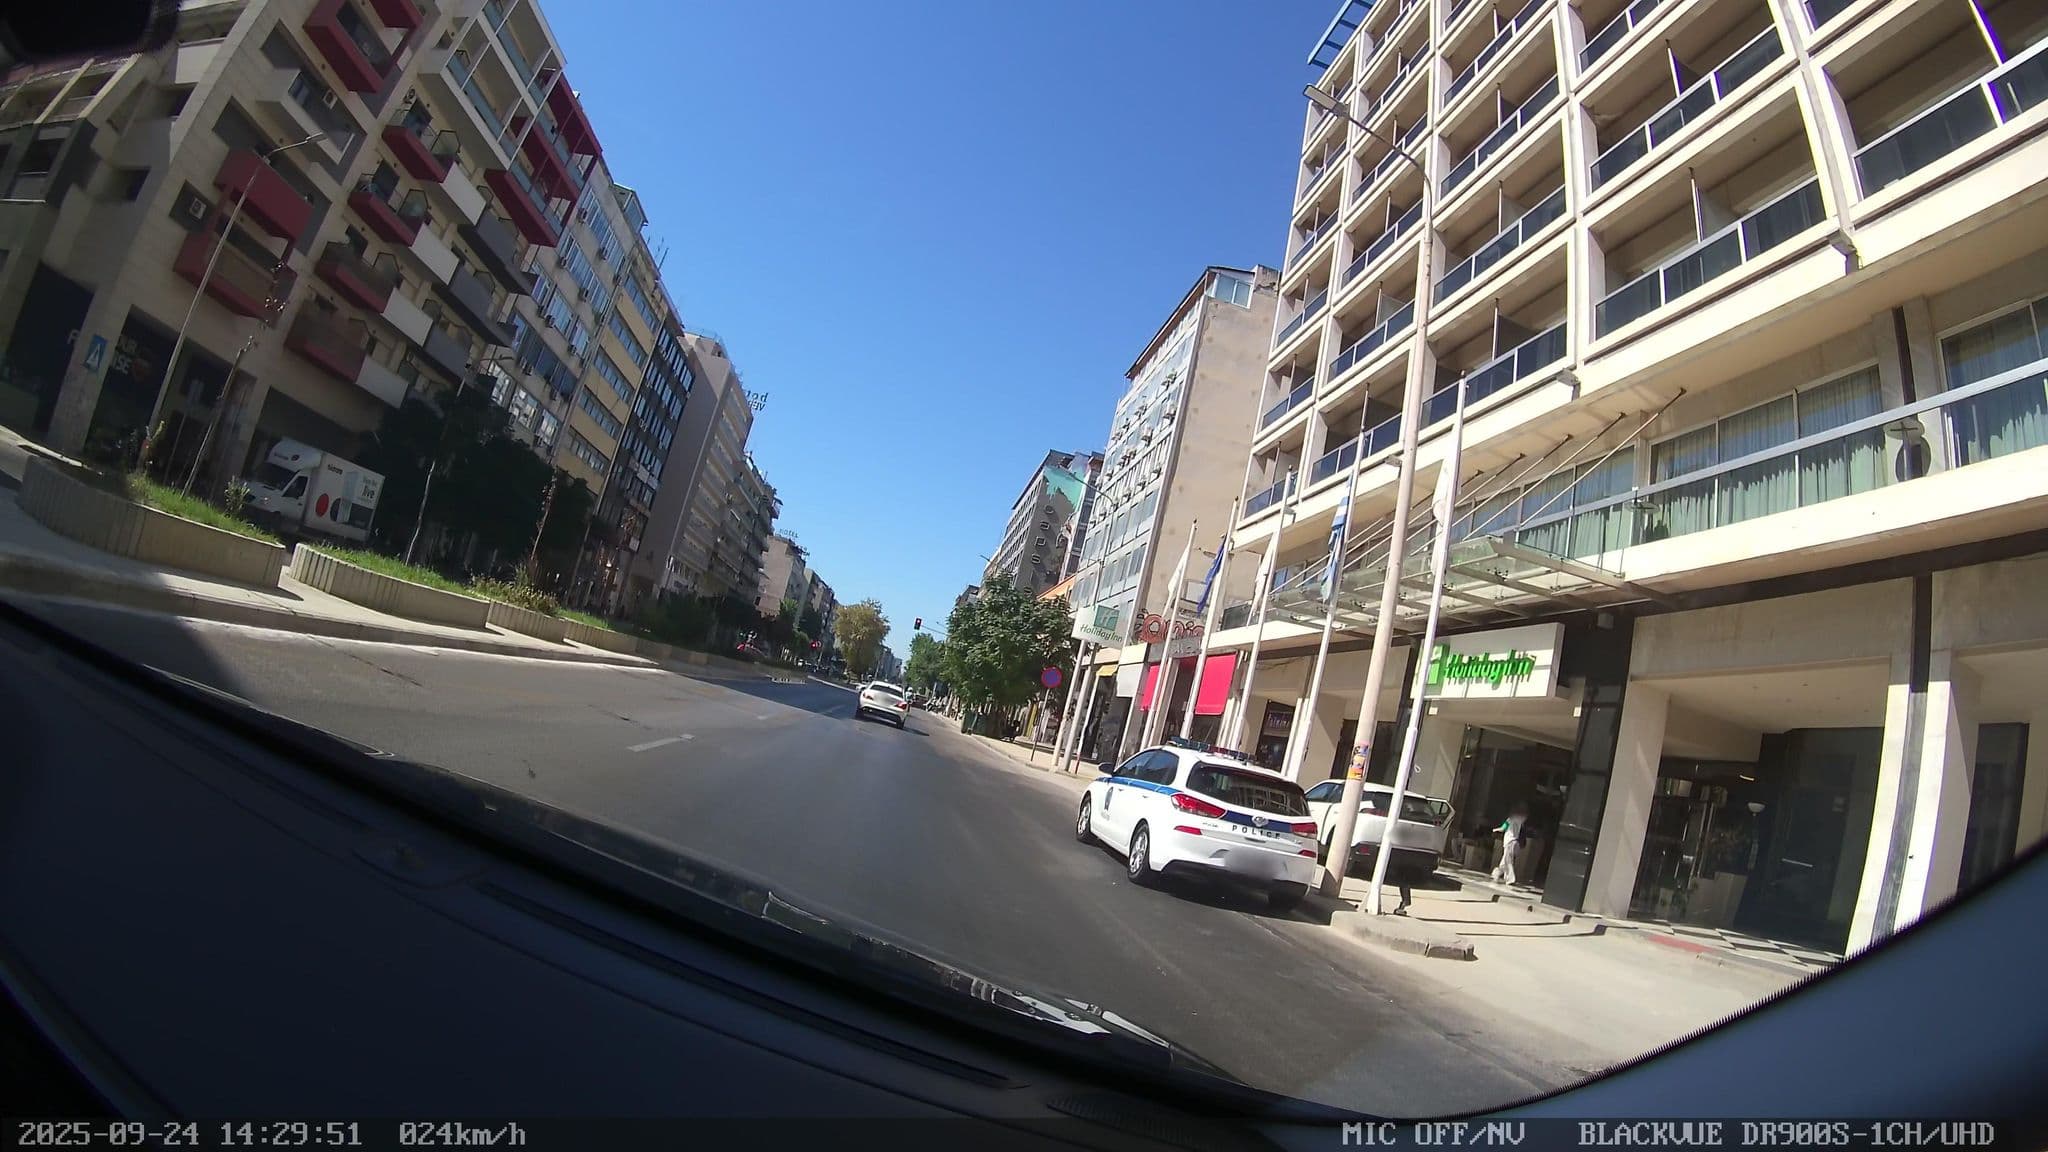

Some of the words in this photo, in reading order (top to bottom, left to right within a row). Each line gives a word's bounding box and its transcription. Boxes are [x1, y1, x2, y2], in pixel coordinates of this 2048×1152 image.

[1080, 624, 1111, 640] Holiday
[1111, 632, 1123, 643] Inn
[1445, 652, 1504, 683] Holiday
[1504, 649, 1537, 677] Inn
[1231, 824, 1281, 839] POLICE
